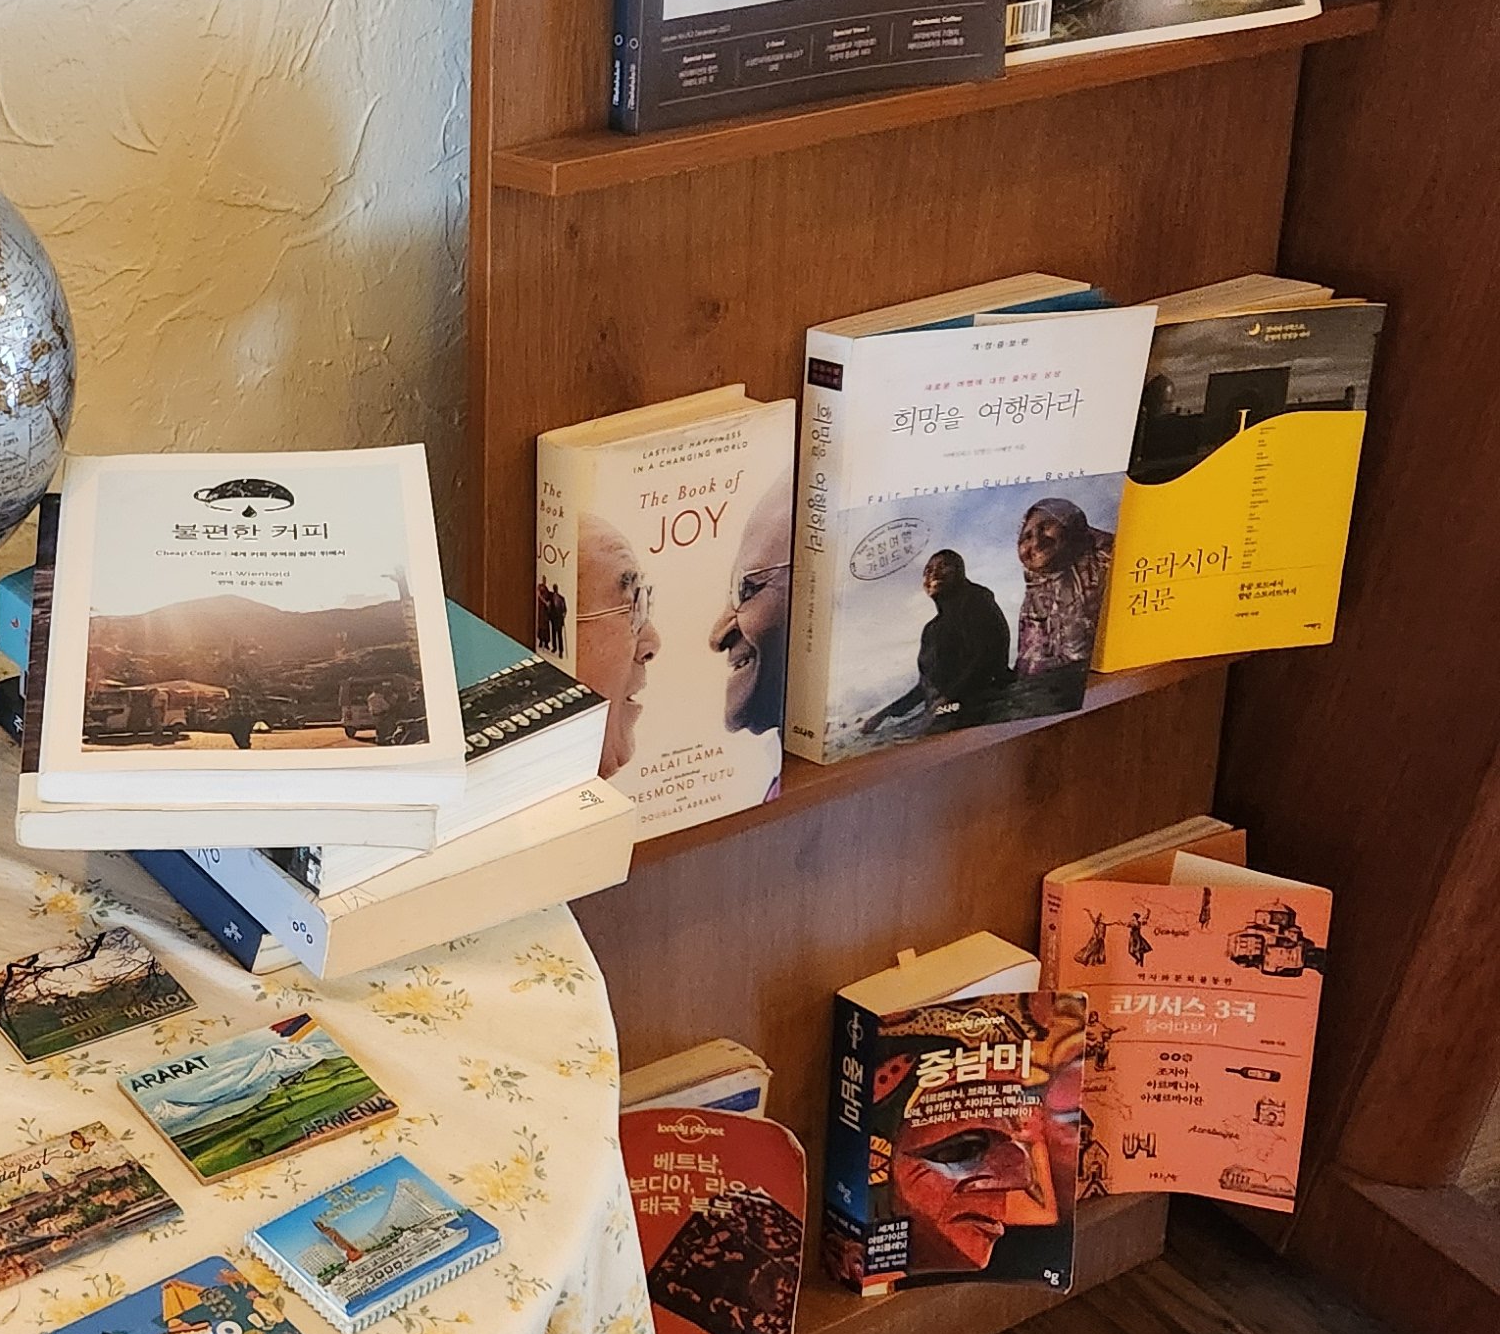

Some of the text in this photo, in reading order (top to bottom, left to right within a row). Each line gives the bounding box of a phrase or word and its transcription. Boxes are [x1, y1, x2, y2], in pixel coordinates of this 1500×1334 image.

[891, 388, 1085, 436] 희망을 여행하라
[642, 429, 742, 460] LASTING HAPPINESS
[812, 402, 833, 460] 희망을
[632, 440, 749, 474] IN A CHANGING WORLD
[543, 481, 562, 498] The
[640, 469, 745, 509] The Book of
[867, 491, 901, 505] Fair
[913, 480, 971, 497] Travel
[982, 473, 1033, 490] Guide
[540, 498, 565, 518] Book
[805, 471, 829, 555] 여행하라
[171, 522, 329, 541] 불편한 커피
[546, 523, 559, 539] of
[649, 501, 728, 554] JOY
[155, 549, 188, 558] Cheap
[189, 549, 223, 558] Coffee
[537, 541, 571, 568] JOY
[1129, 545, 1233, 584] 유라시아
[210, 569, 291, 578] Karl Wienhold
[1127, 586, 1175, 616] 견문
[640, 757, 681, 777] DALAI
[687, 746, 725, 764] LAMA
[628, 778, 696, 804] DESMOND
[701, 767, 735, 784] TUTU
[687, 794, 722, 810] ABRAMS
[124, 991, 189, 1019] HANOI
[1108, 993, 1257, 1024] 코카서스 3국
[130, 1054, 213, 1093] ARARAT
[915, 1039, 1032, 1088] 중남미
[838, 1054, 865, 1134] 중남미
[953, 1101, 963, 1110] &
[300, 1095, 397, 1140] ARMENIA
[657, 1123, 726, 1137] lonely planet
[653, 1151, 724, 1176] 베트남,
[630, 1173, 773, 1205] 보디아, 라오스
[639, 1195, 734, 1219] 태국 북부
